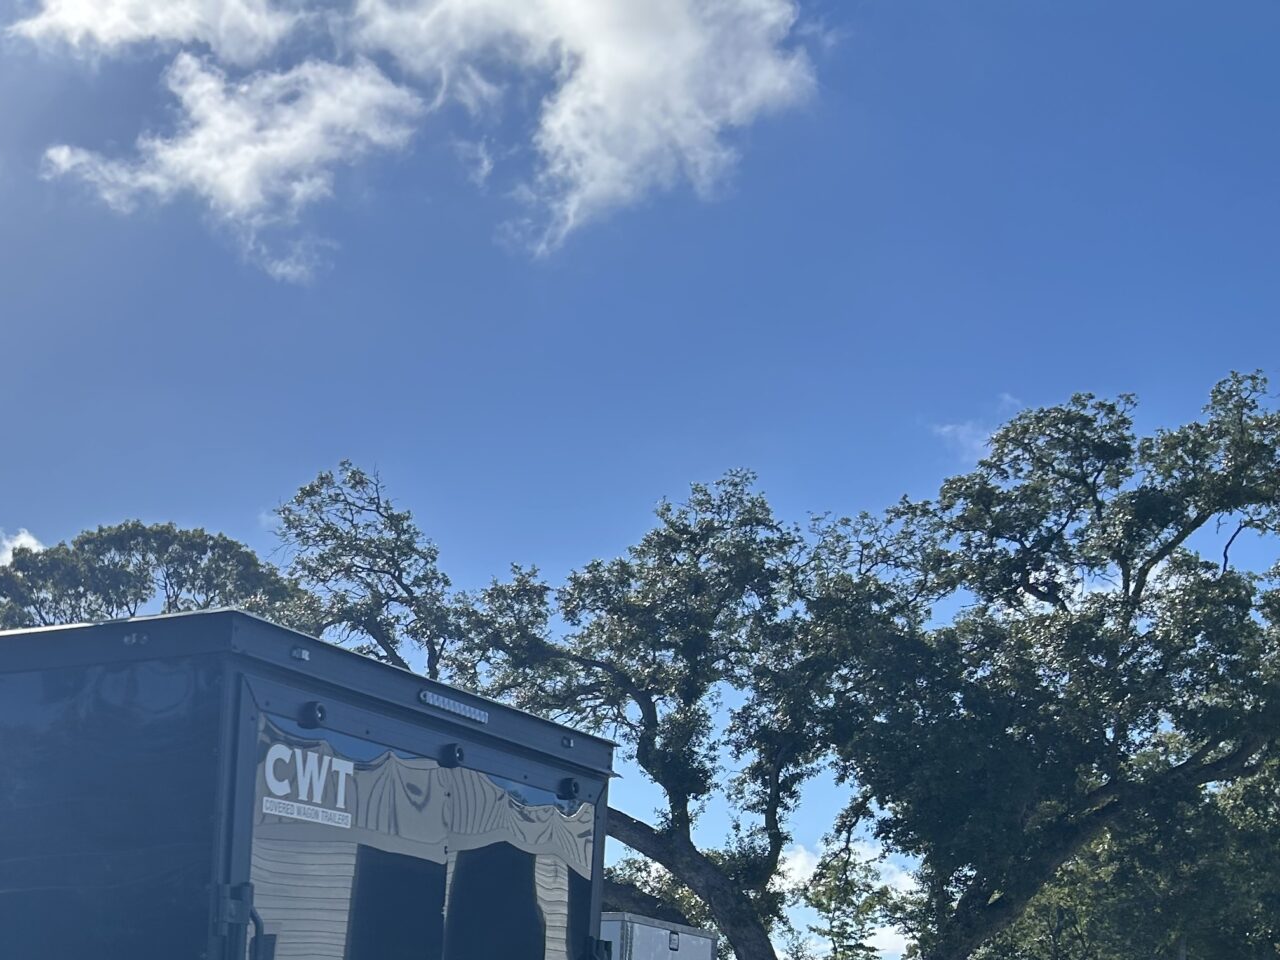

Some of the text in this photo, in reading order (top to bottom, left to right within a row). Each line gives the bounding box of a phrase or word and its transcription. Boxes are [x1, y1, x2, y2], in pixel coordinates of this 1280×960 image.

[265, 744, 354, 809] CWT
[264, 799, 350, 827] COVERED WAGON TRAILERS
